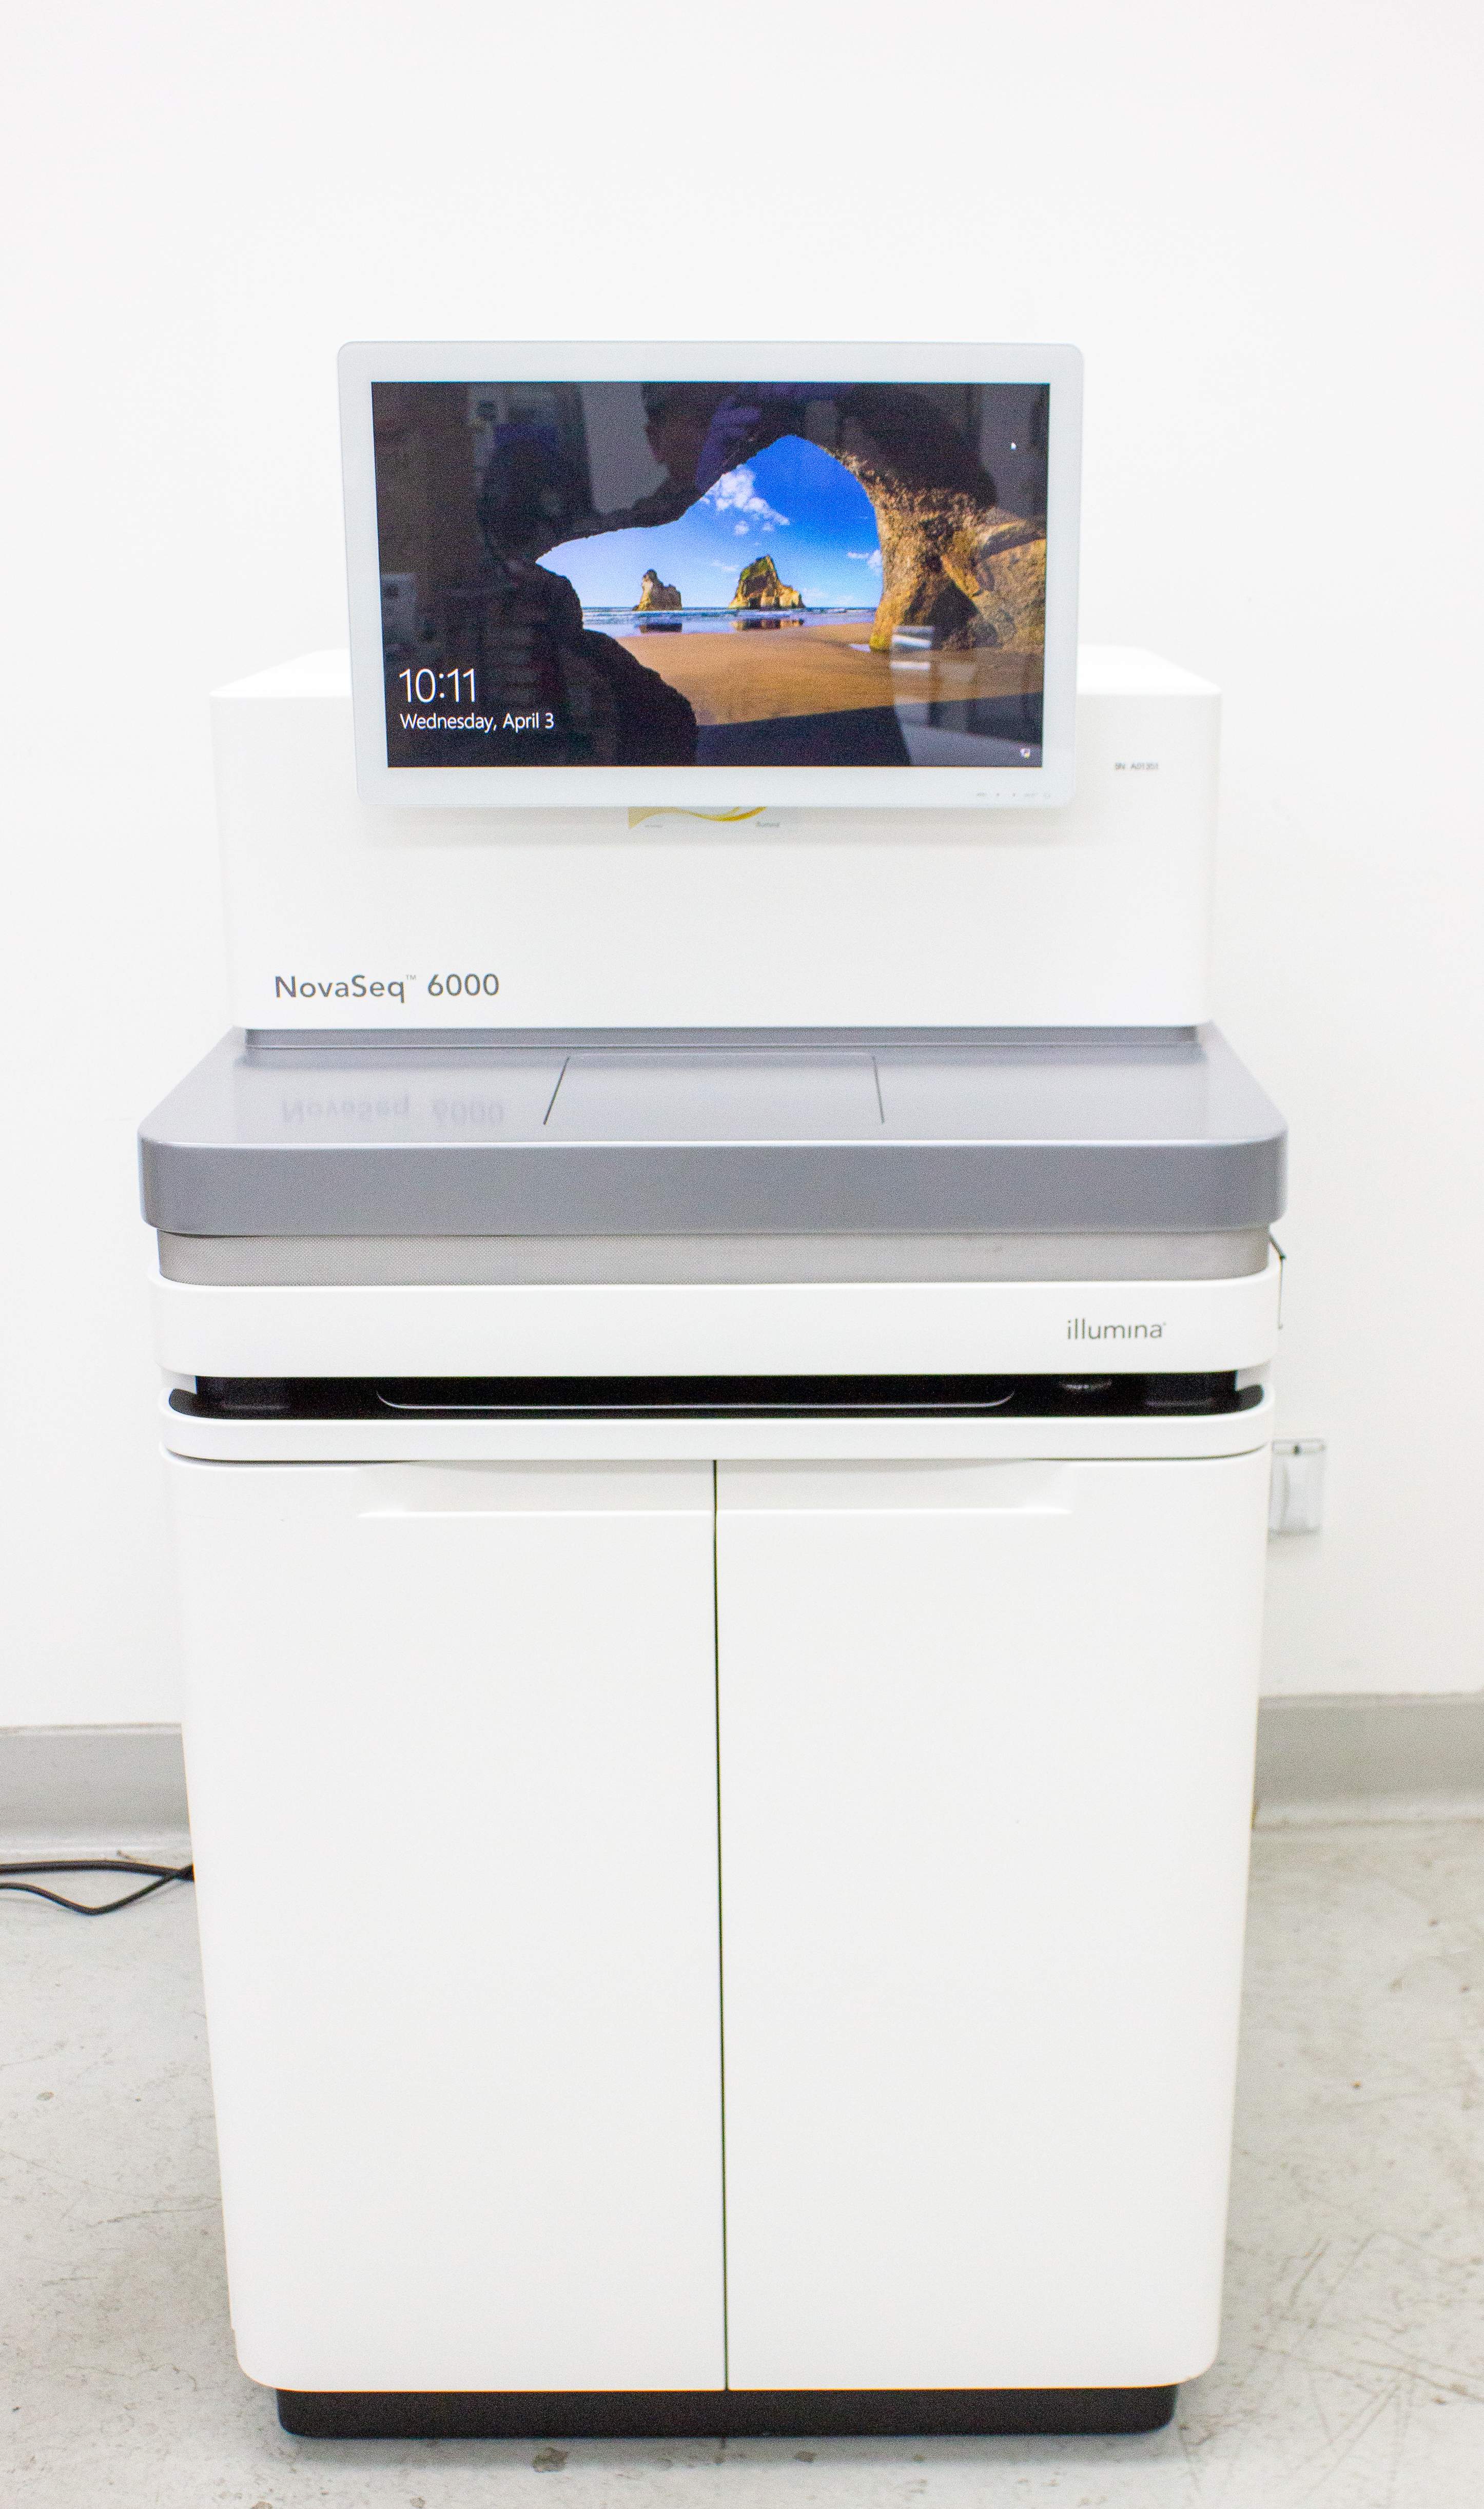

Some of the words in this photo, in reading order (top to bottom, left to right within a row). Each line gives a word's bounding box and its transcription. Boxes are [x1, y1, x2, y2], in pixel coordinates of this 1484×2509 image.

[399, 668, 476, 703] 10:11
[399, 712, 497, 733] Wednesday,
[502, 712, 539, 733] April
[545, 712, 554, 729] 3
[428, 974, 499, 996] 6000
[1067, 1318, 1163, 1340] illumina
